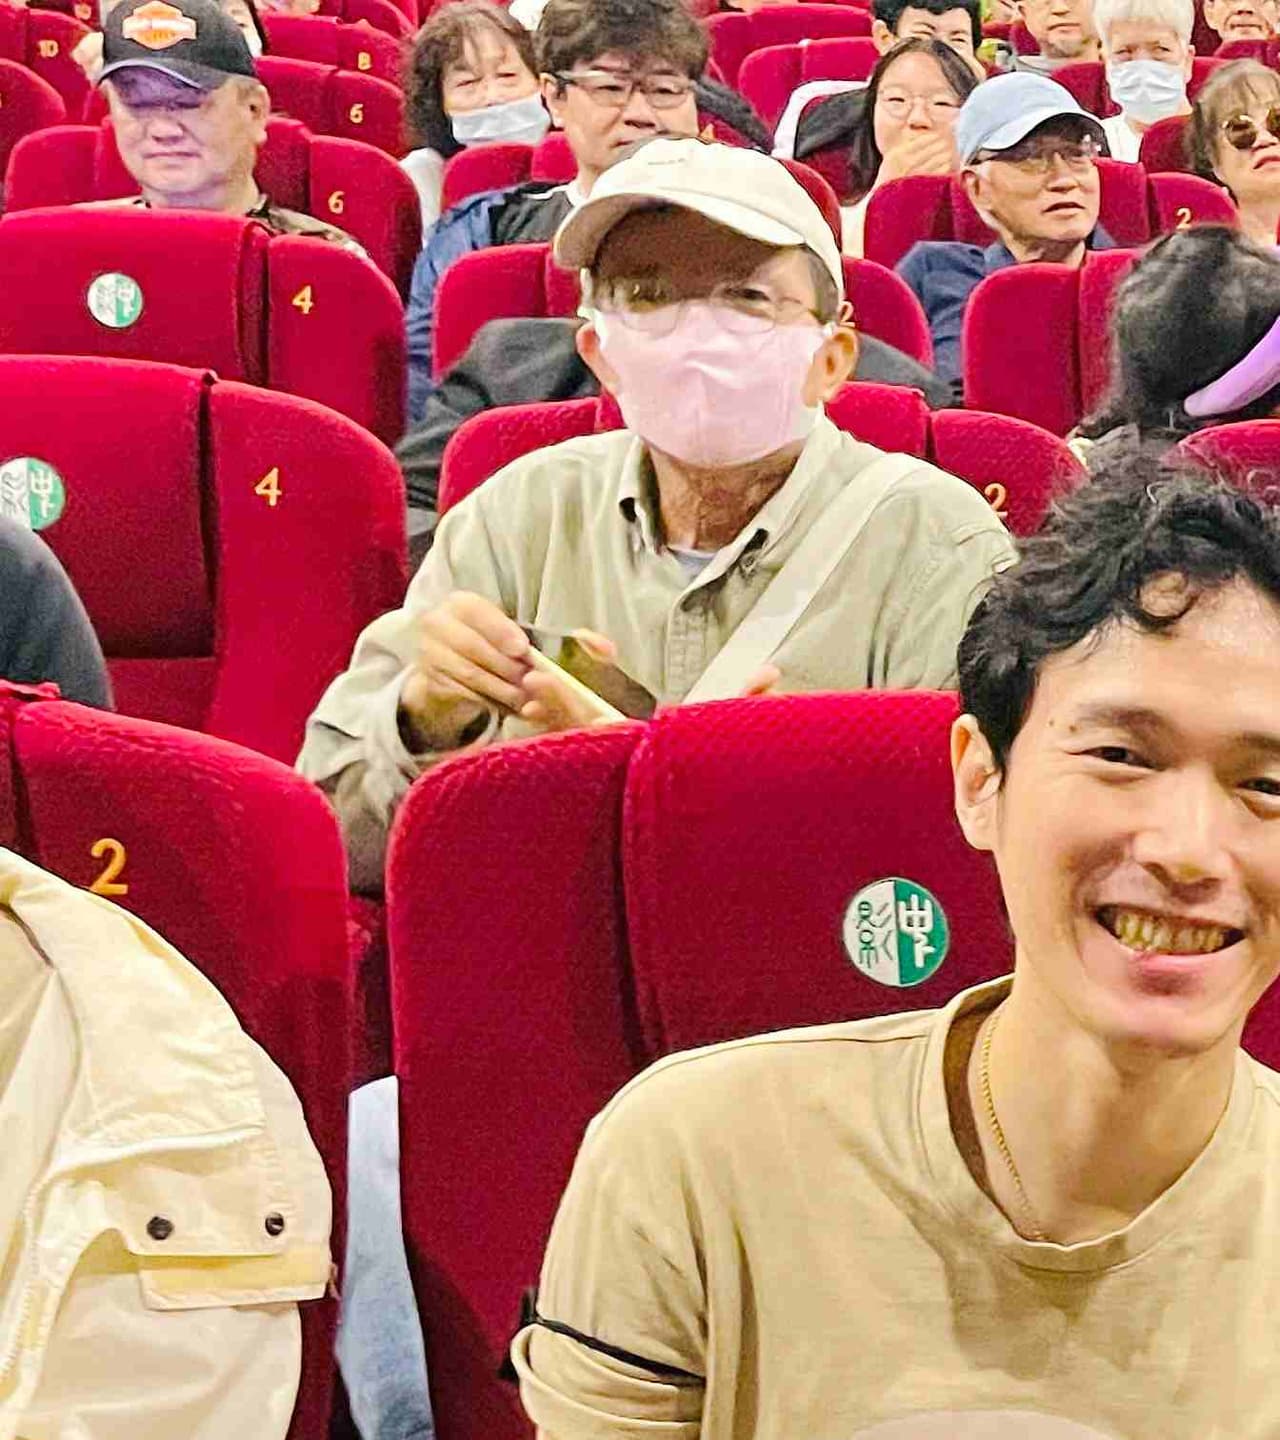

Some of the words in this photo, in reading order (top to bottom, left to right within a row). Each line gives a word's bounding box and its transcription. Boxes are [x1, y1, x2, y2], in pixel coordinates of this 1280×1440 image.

[328, 191, 344, 214] 6
[1176, 206, 1193, 229] 2
[292, 285, 313, 314] 4
[254, 467, 282, 507] 4
[982, 482, 1008, 518] 2
[90, 838, 129, 896] 2
